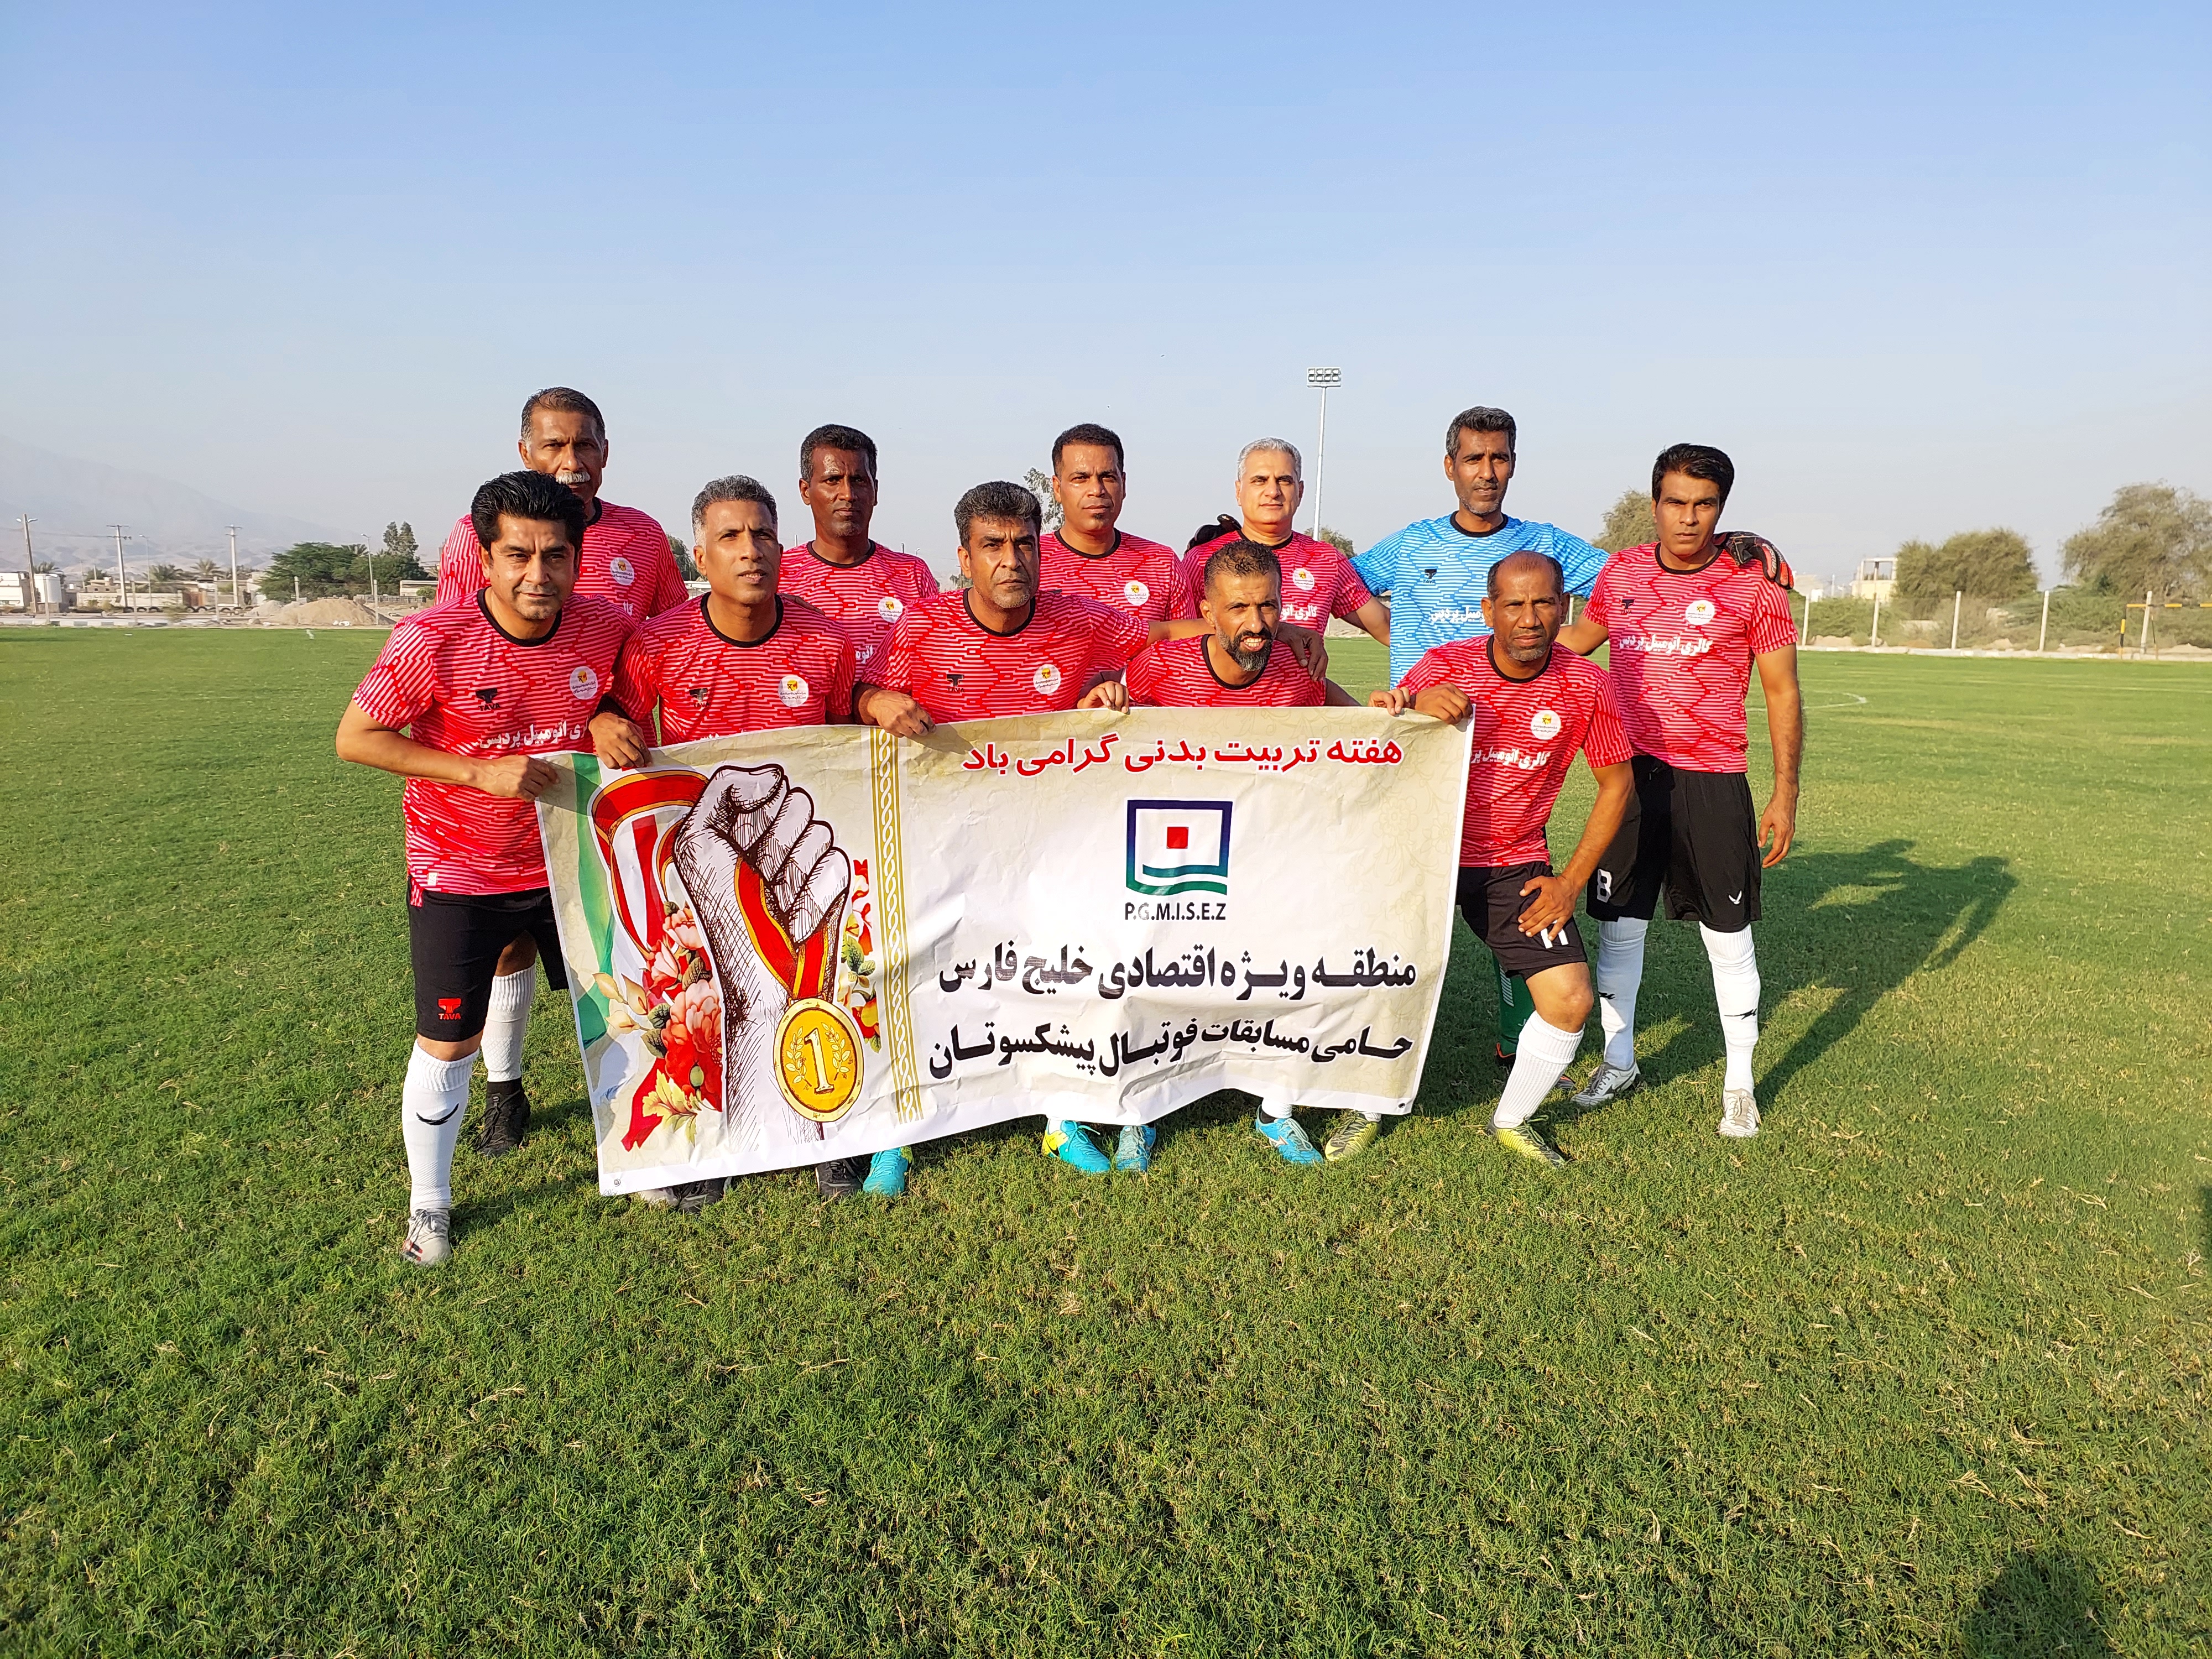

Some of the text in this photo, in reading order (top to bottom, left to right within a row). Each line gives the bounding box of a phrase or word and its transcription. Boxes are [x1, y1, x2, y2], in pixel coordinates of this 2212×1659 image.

[1645, 634, 1681, 654] اتومبیل
[1681, 638, 1713, 656] گالری
[478, 703, 500, 711] TAVA
[479, 731, 520, 748] پردیس
[524, 720, 567, 745] اتومبیل
[962, 733, 1402, 776] هفته تربیت بدنی گرامی باد
[1483, 745, 1519, 765] اتومبیل
[1519, 751, 1551, 769] گالری
[1597, 868, 1611, 902] 8
[1125, 901, 1226, 921] P.G.M.I.S.E.Z
[940, 940, 1416, 1000] منطقه ویژه اقتصادی خلیج فارس
[929, 1018, 1415, 1079] حامی مسابقات فوتبال پیشکسوتان
[804, 1027, 835, 1095] 1
